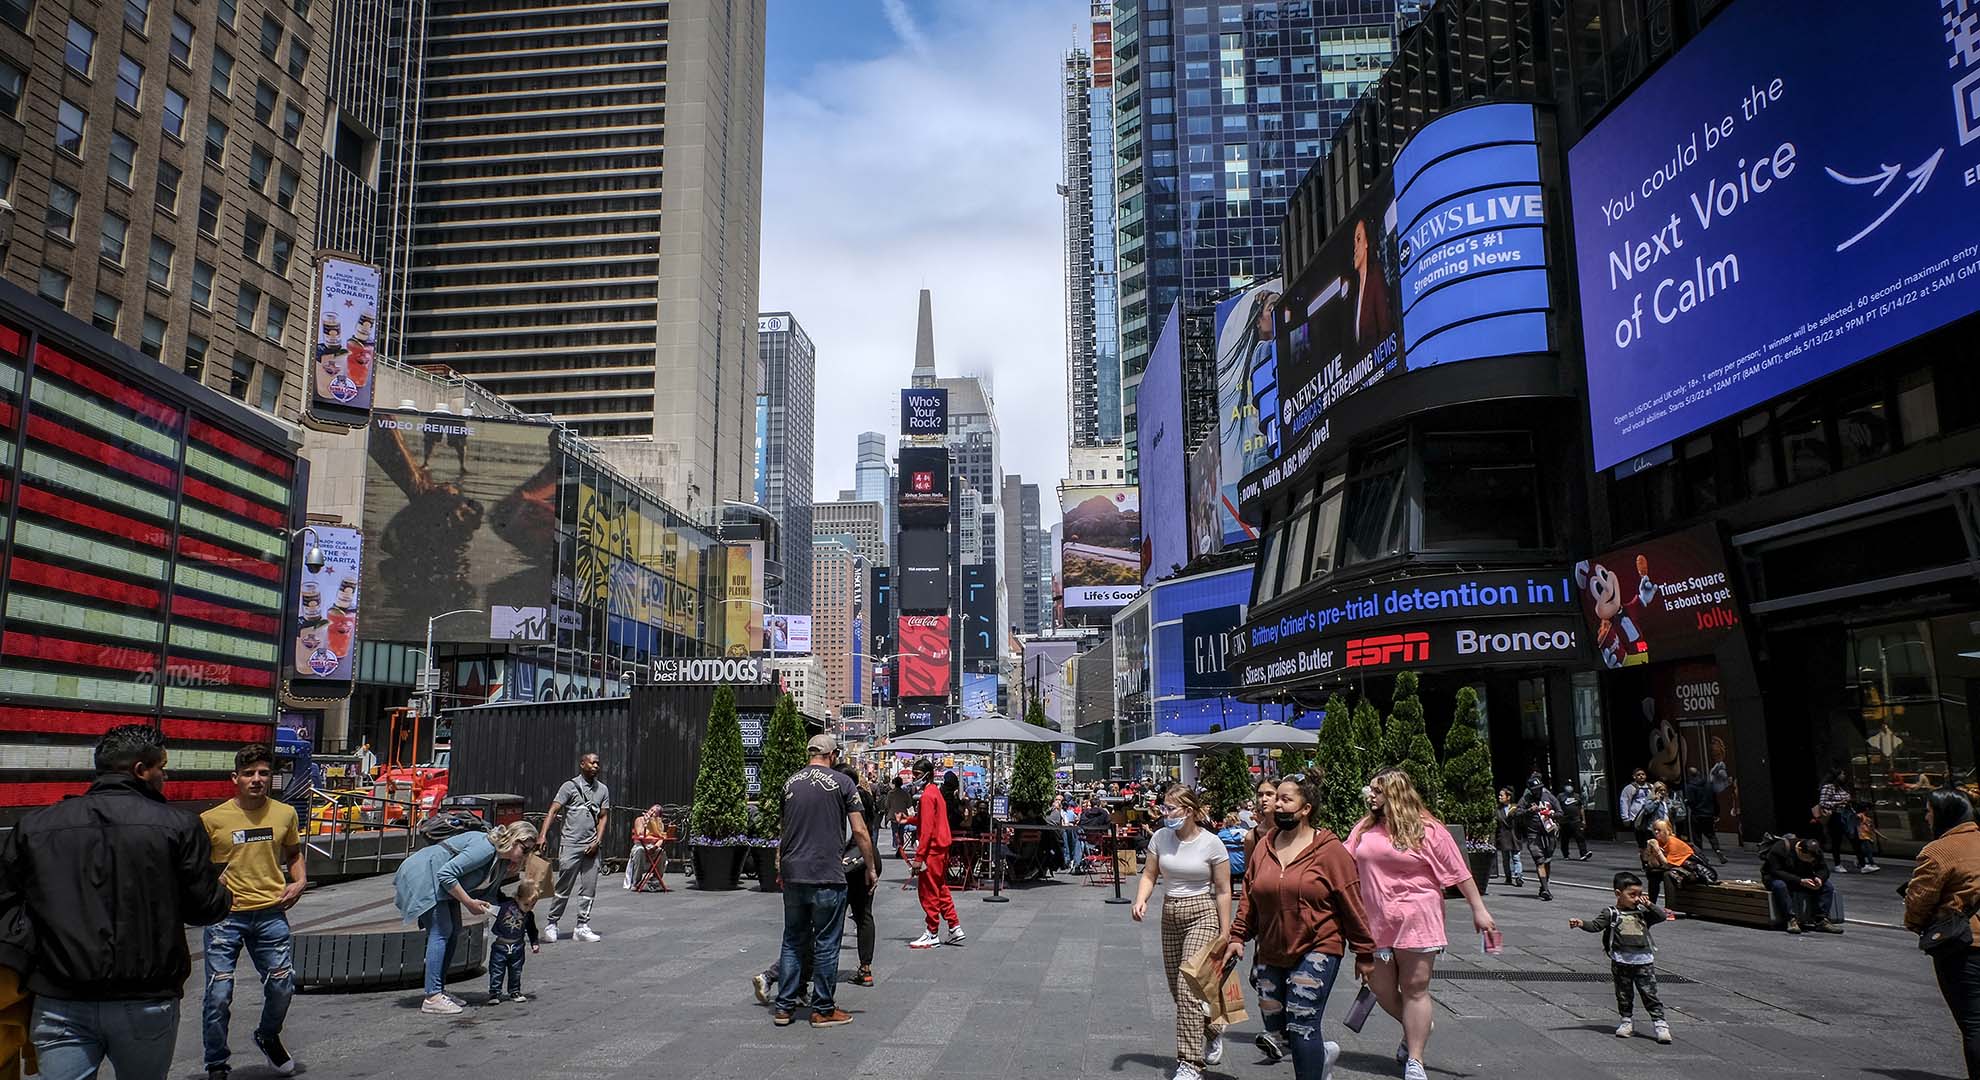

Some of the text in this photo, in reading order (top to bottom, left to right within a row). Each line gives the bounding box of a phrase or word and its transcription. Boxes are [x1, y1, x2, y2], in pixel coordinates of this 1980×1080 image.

[1602, 77, 1784, 227] You could be the
[1608, 142, 1797, 290] Next Voice
[1418, 232, 1504, 274] America's #1
[1414, 250, 1521, 295] Streaming News
[325, 286, 374, 300] CORONARITA
[1615, 252, 1740, 348] of Calm
[1614, 414, 1628, 425] Open
[1634, 400, 1652, 416] US/DC
[1653, 394, 1664, 406] and
[1663, 390, 1672, 400] UK
[1707, 366, 1724, 380] entry
[1724, 360, 1736, 374] per
[1768, 334, 1792, 350] winner
[1792, 324, 1806, 338] will
[1807, 322, 1818, 332] be
[1820, 302, 1856, 326] selected.
[1857, 296, 1868, 308] 60
[1870, 278, 1902, 302] second
[1904, 258, 1950, 287] maximum
[1952, 244, 1978, 263] entry
[1331, 353, 1374, 402] STREAMING
[1374, 332, 1397, 367] NEWS
[1622, 424, 1632, 435] and
[1632, 416, 1646, 430] vocal
[1668, 401, 1685, 414] Starts
[1685, 389, 1705, 406] 5/3/22
[1705, 388, 1712, 396] at
[1713, 378, 1732, 392] 12AM
[1732, 372, 1742, 384] PT
[1742, 364, 1760, 380] (8AM
[1784, 346, 1802, 360] ends
[1803, 330, 1834, 351] 5/13/22
[1835, 326, 1844, 336] at
[1845, 314, 1864, 332] 9PM
[1866, 308, 1878, 322] PT
[1880, 290, 1918, 317] (5/14/22
[1920, 286, 1930, 298] at
[1932, 272, 1956, 292] 5AM
[908, 396, 940, 407] Who's
[912, 406, 936, 418] Your
[378, 419, 475, 436] VIDEO PREMIERE
[910, 416, 942, 428] Rock?
[1242, 419, 1330, 502] now, with ABC News Live!
[732, 575, 746, 586] NOW
[1084, 590, 1140, 600] Life's Good
[1658, 572, 1726, 596] Times Square
[1252, 623, 1279, 648] Brittney
[1280, 609, 1316, 638] Griner's
[1318, 594, 1379, 632] pre-trial
[1384, 582, 1518, 614] detention
[1528, 579, 1554, 603] in
[1664, 588, 1732, 612] is about to get
[1195, 632, 1229, 675] GAP
[1346, 632, 1430, 668] ESPN
[654, 660, 678, 671] NYC's
[654, 671, 678, 682] best
[1267, 656, 1297, 684] praises
[1298, 648, 1333, 673] Butler
[1676, 681, 1720, 699] COMING
[1682, 696, 1716, 712] SOON
